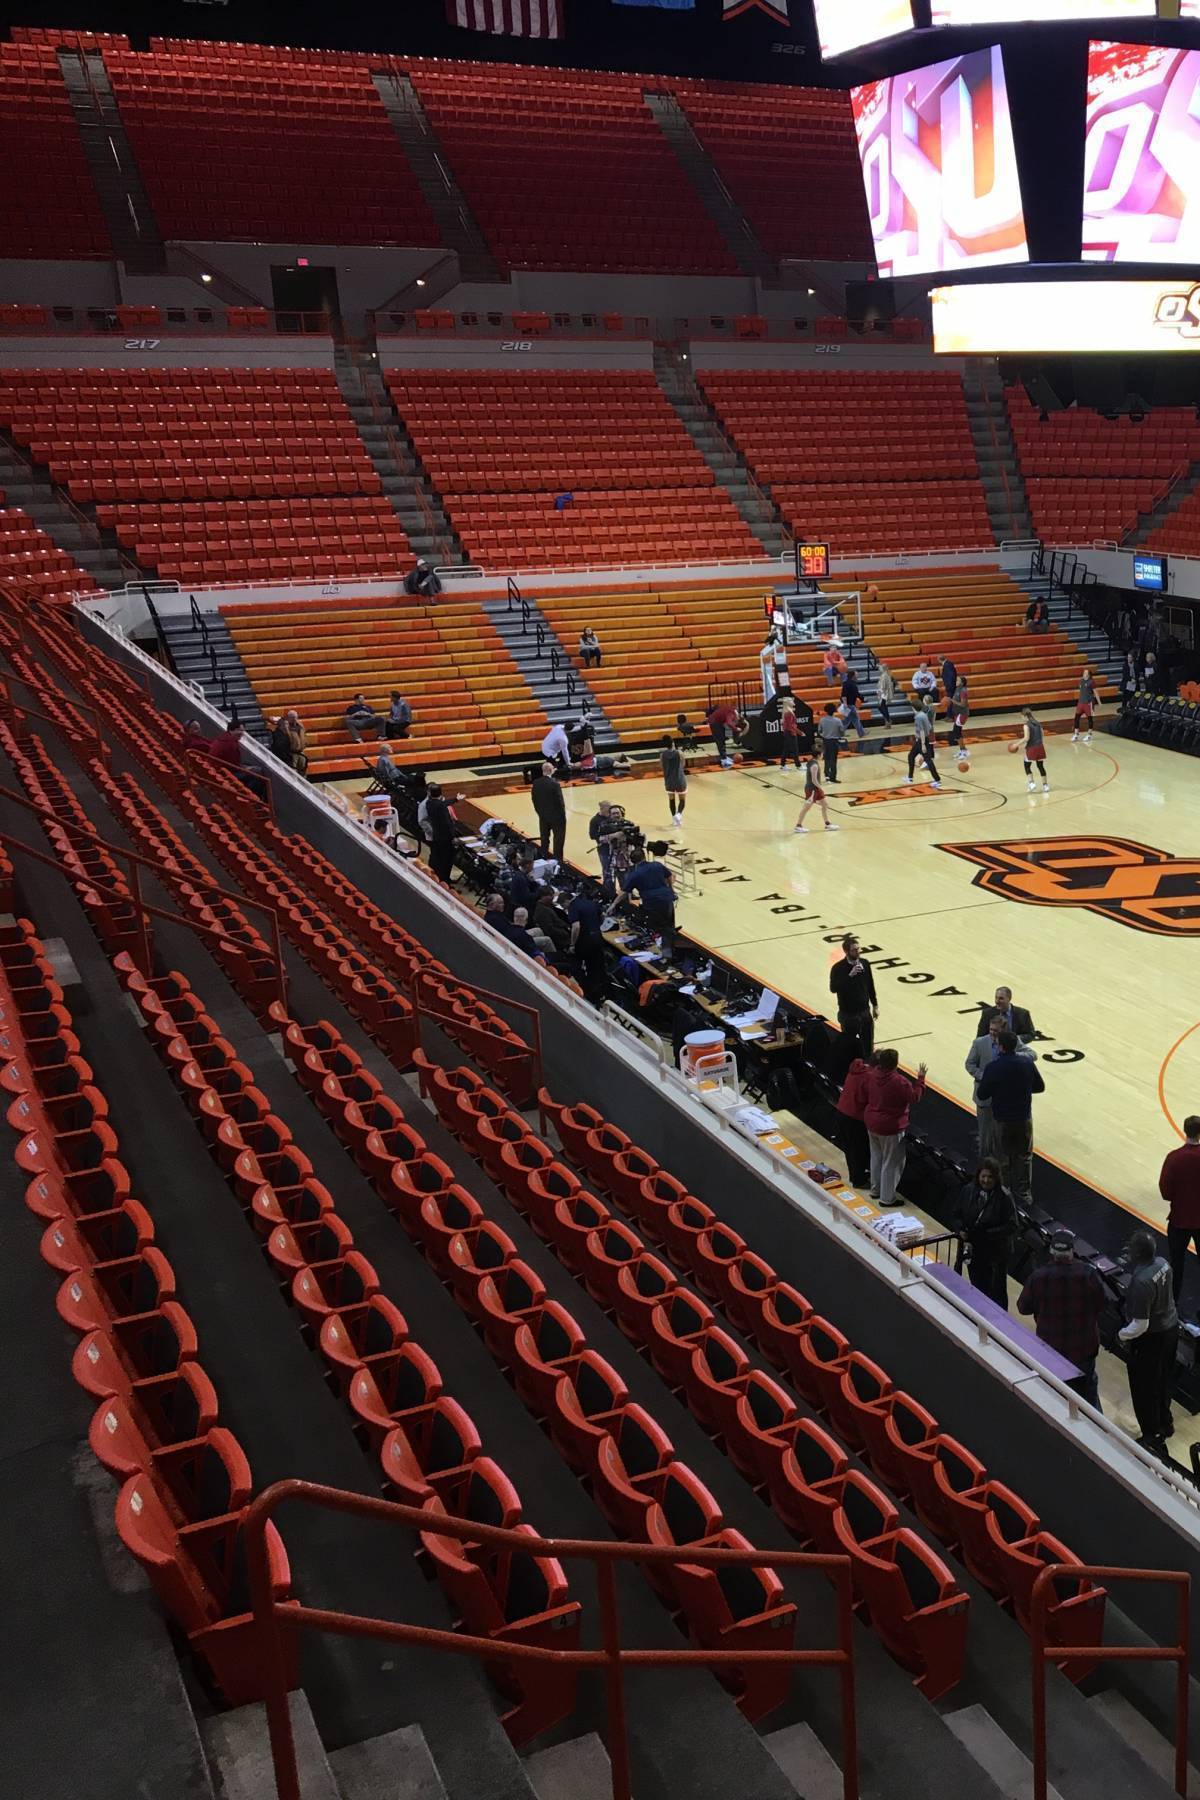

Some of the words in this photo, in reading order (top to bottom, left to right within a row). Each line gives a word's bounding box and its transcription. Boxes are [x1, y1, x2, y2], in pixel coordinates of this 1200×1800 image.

[124, 339, 161, 349] 217
[501, 341, 532, 351] 218
[815, 344, 841, 353] 219
[805, 557, 822, 574] 30
